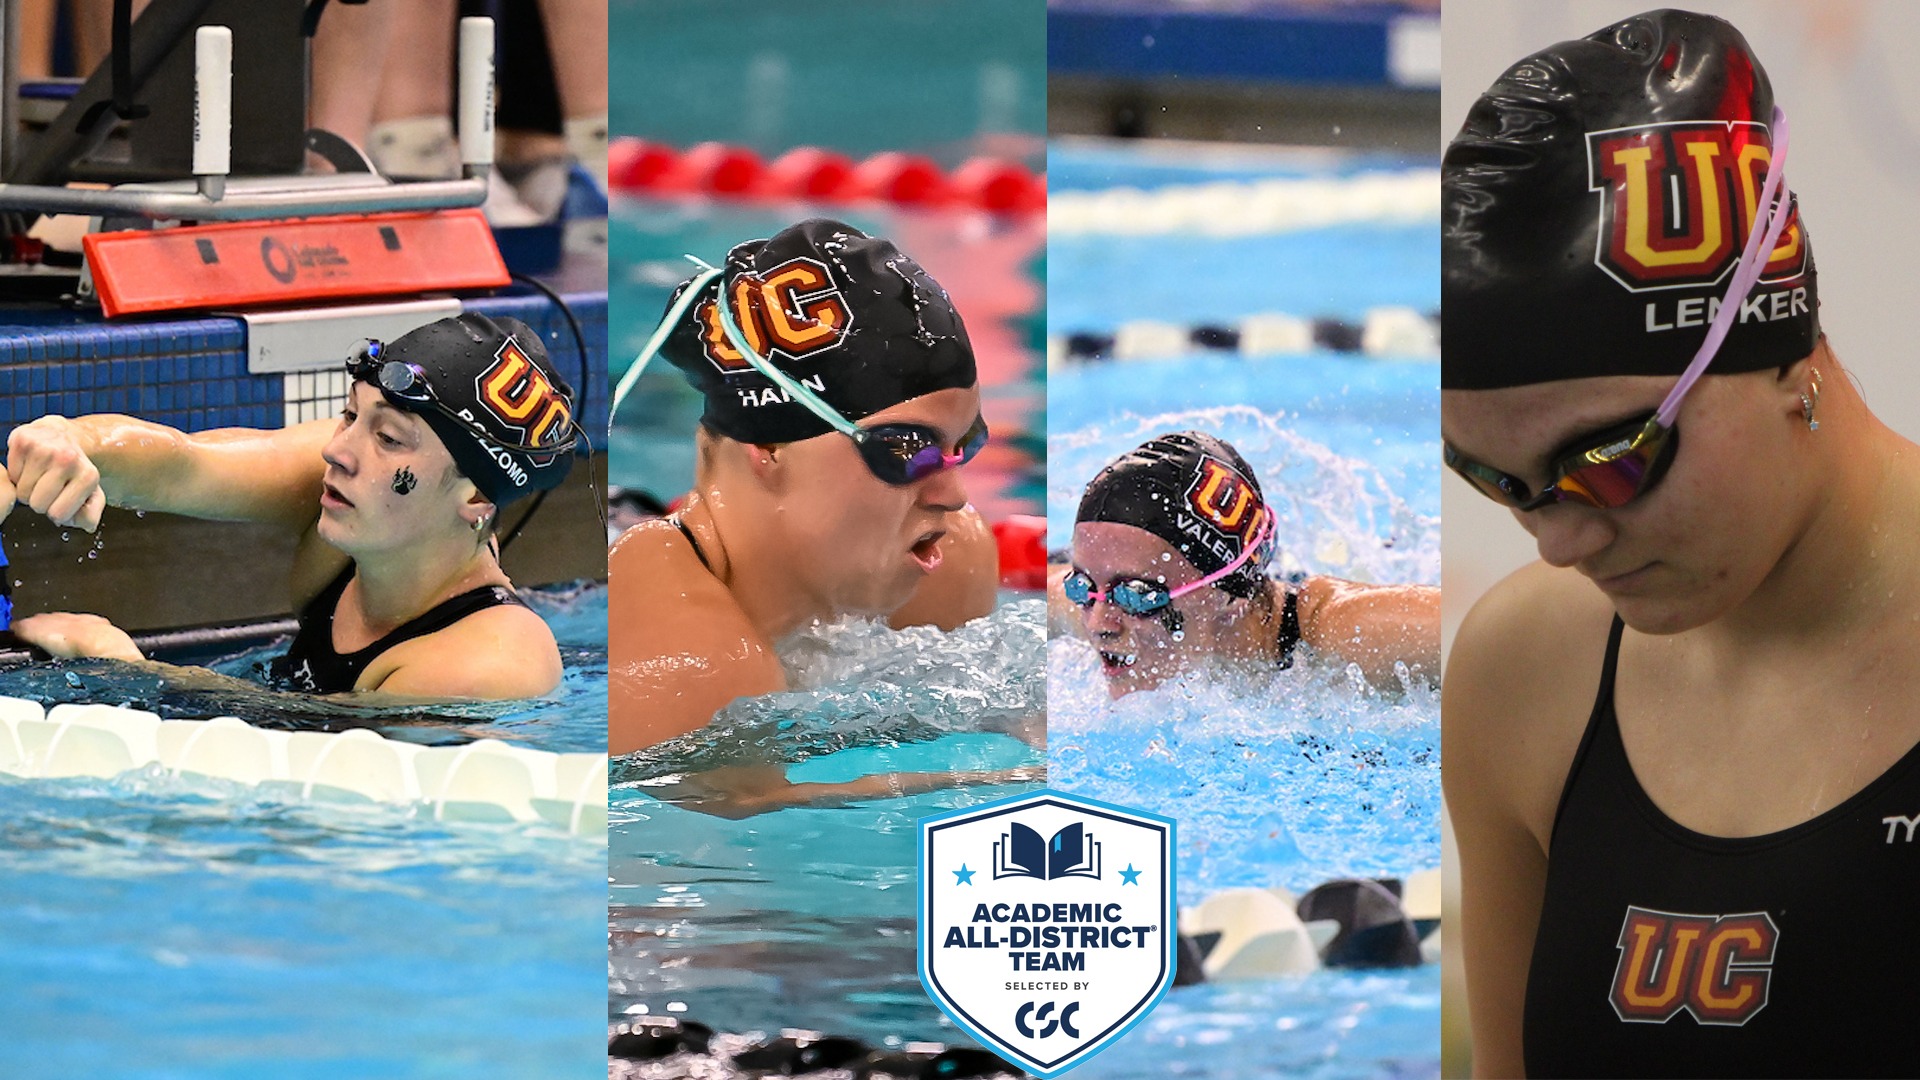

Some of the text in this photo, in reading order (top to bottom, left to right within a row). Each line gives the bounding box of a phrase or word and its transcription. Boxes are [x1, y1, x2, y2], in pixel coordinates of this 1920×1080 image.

[1595, 126, 1805, 286] UC
[699, 260, 848, 369] UC
[480, 342, 572, 462] UC
[1614, 911, 1774, 1020] UC
